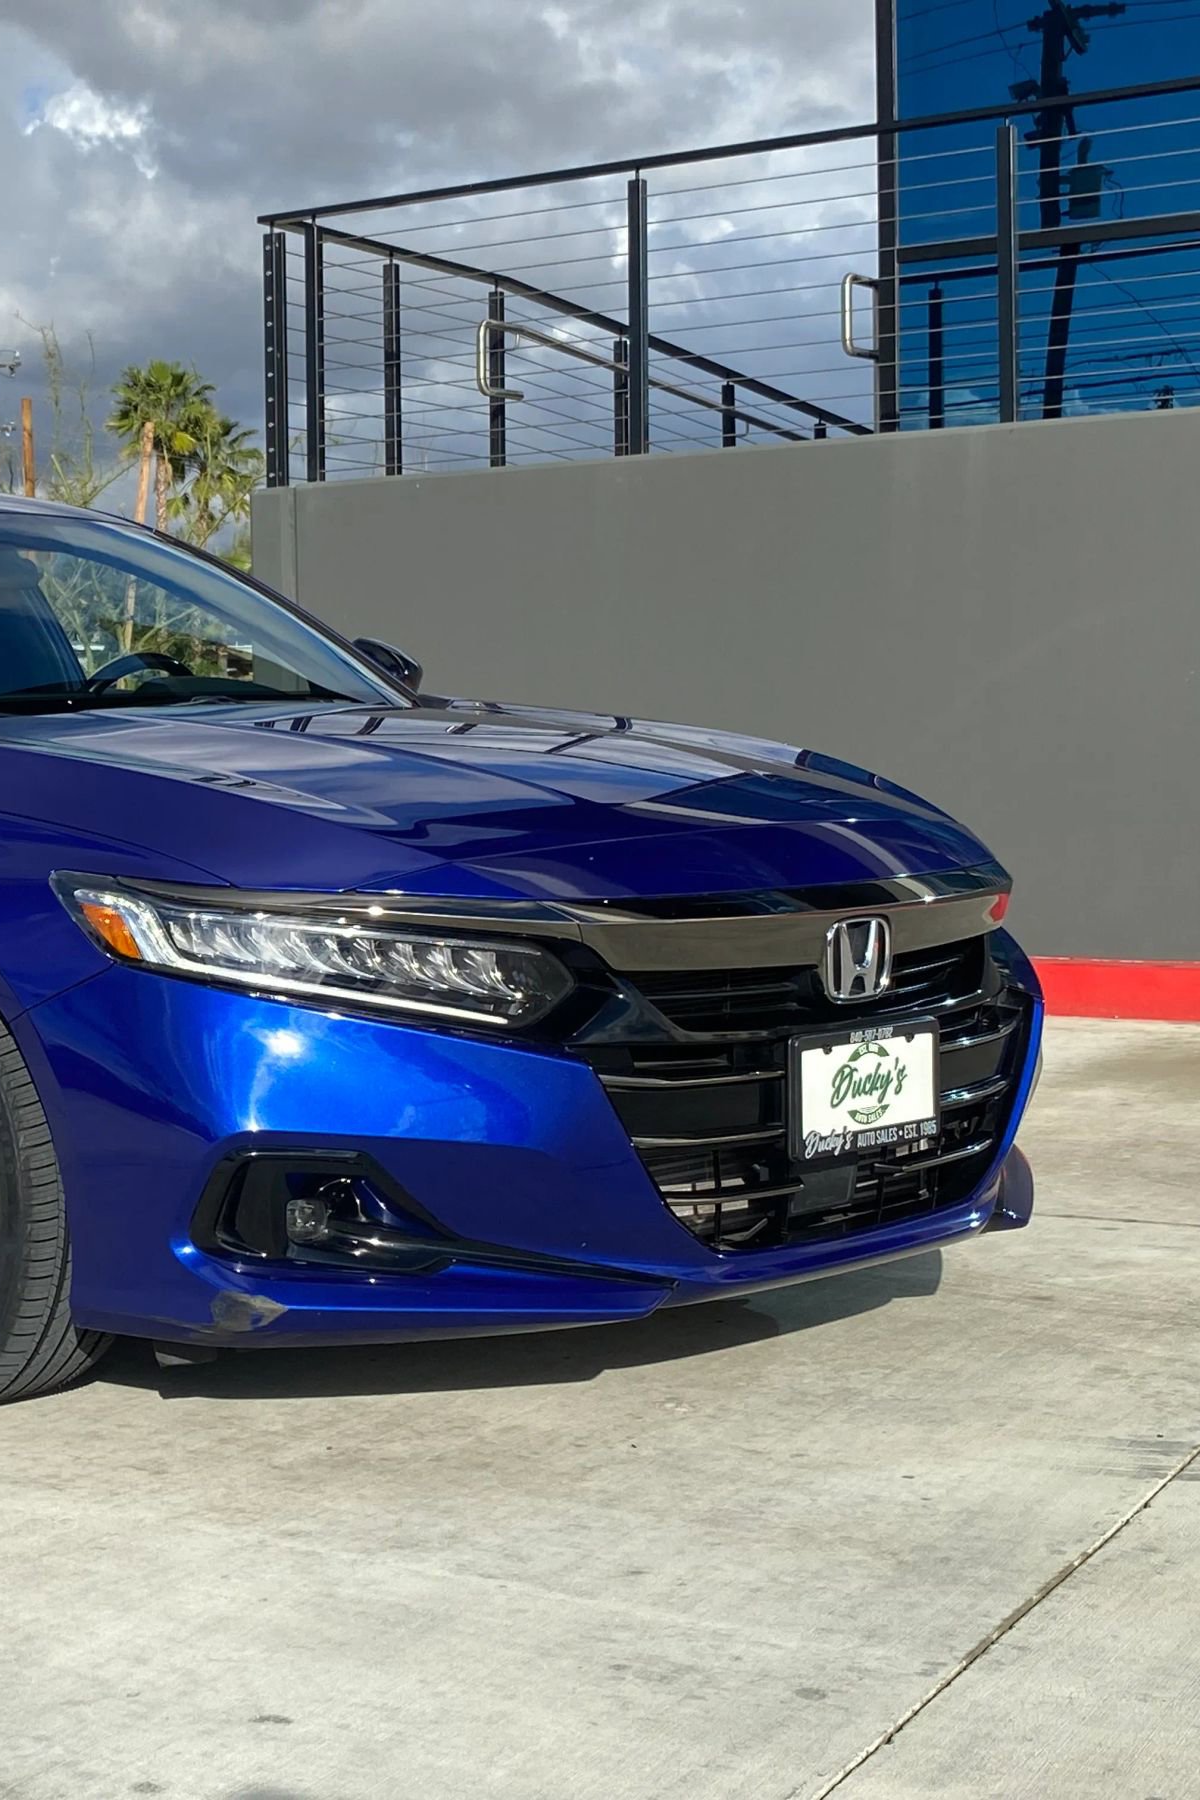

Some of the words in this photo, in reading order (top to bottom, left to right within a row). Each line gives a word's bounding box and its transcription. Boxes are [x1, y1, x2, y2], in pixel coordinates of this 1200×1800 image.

[830, 1056, 908, 1108] Ducky's
[804, 1126, 854, 1159] Ducky's
[857, 1131, 875, 1148] AUTO
[876, 1126, 897, 1144] SALES
[904, 1124, 917, 1140] EST.
[920, 1120, 937, 1136] 1985
